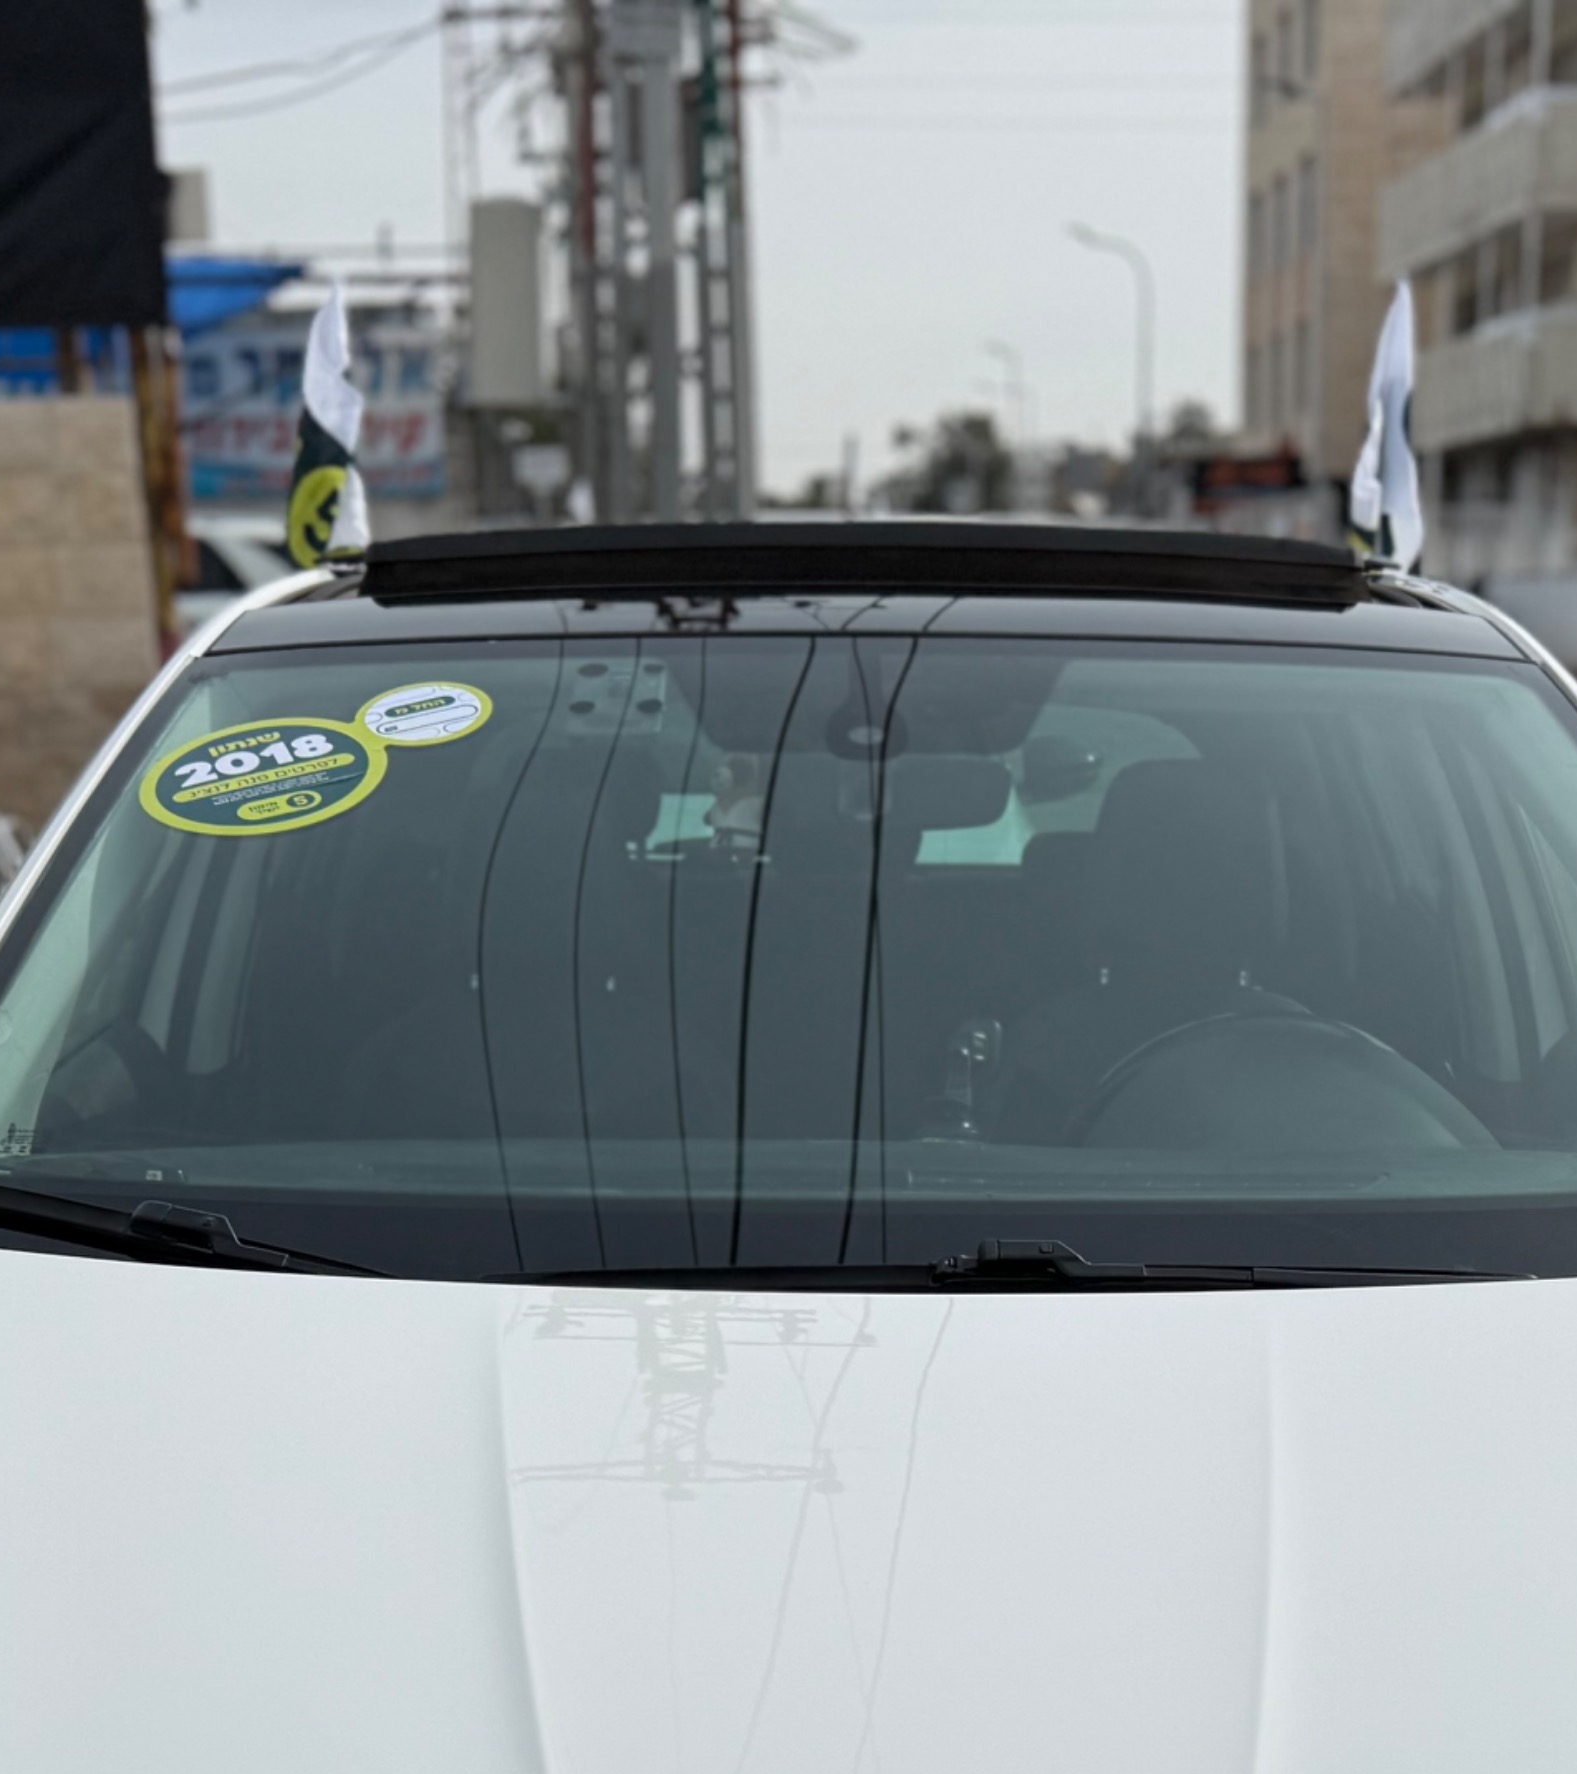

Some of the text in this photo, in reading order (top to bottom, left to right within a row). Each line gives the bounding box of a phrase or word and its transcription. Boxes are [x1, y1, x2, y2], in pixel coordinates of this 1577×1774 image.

[208, 731, 281, 758] שנתון
[174, 734, 334, 789] 2018
[275, 757, 338, 778] לפרטים
[238, 772, 270, 788] פנה
